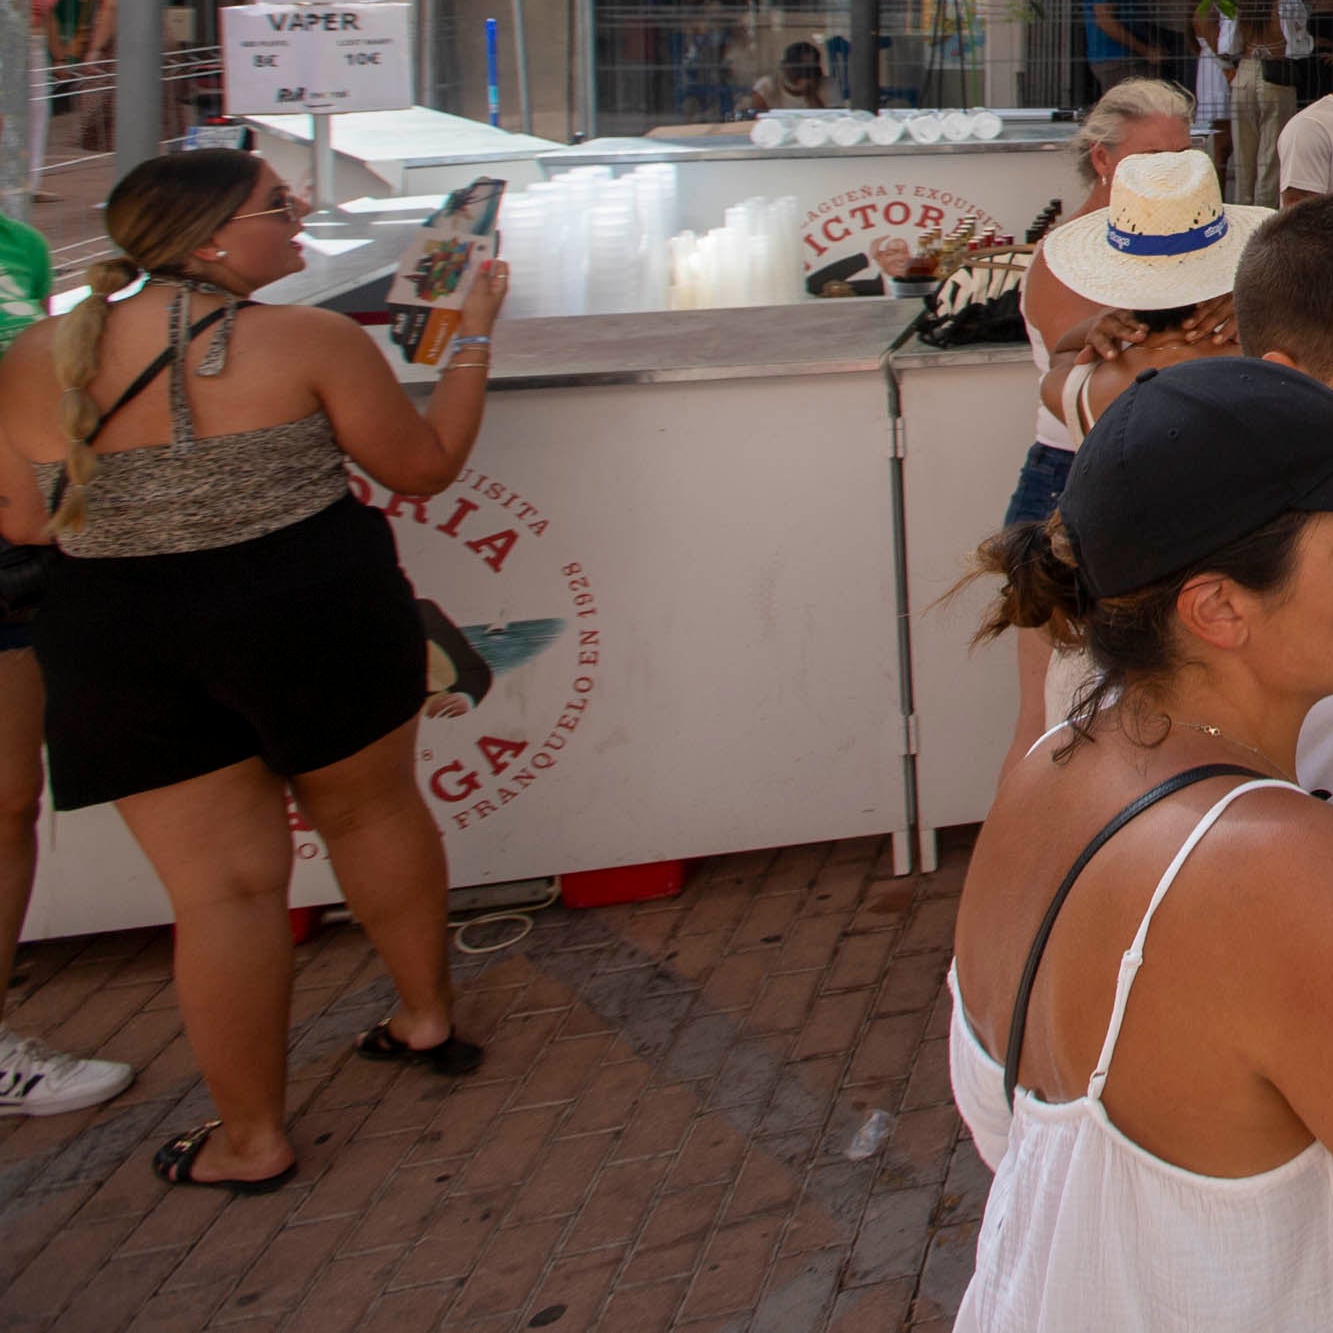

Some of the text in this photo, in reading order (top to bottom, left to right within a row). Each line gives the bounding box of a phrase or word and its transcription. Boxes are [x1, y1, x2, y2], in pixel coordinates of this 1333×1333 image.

[266, 12, 363, 32] VAPER
[345, 52, 383, 66] 10€
[894, 184, 907, 195] Y
[452, 561, 601, 831] FRANQUELO EN 1928
